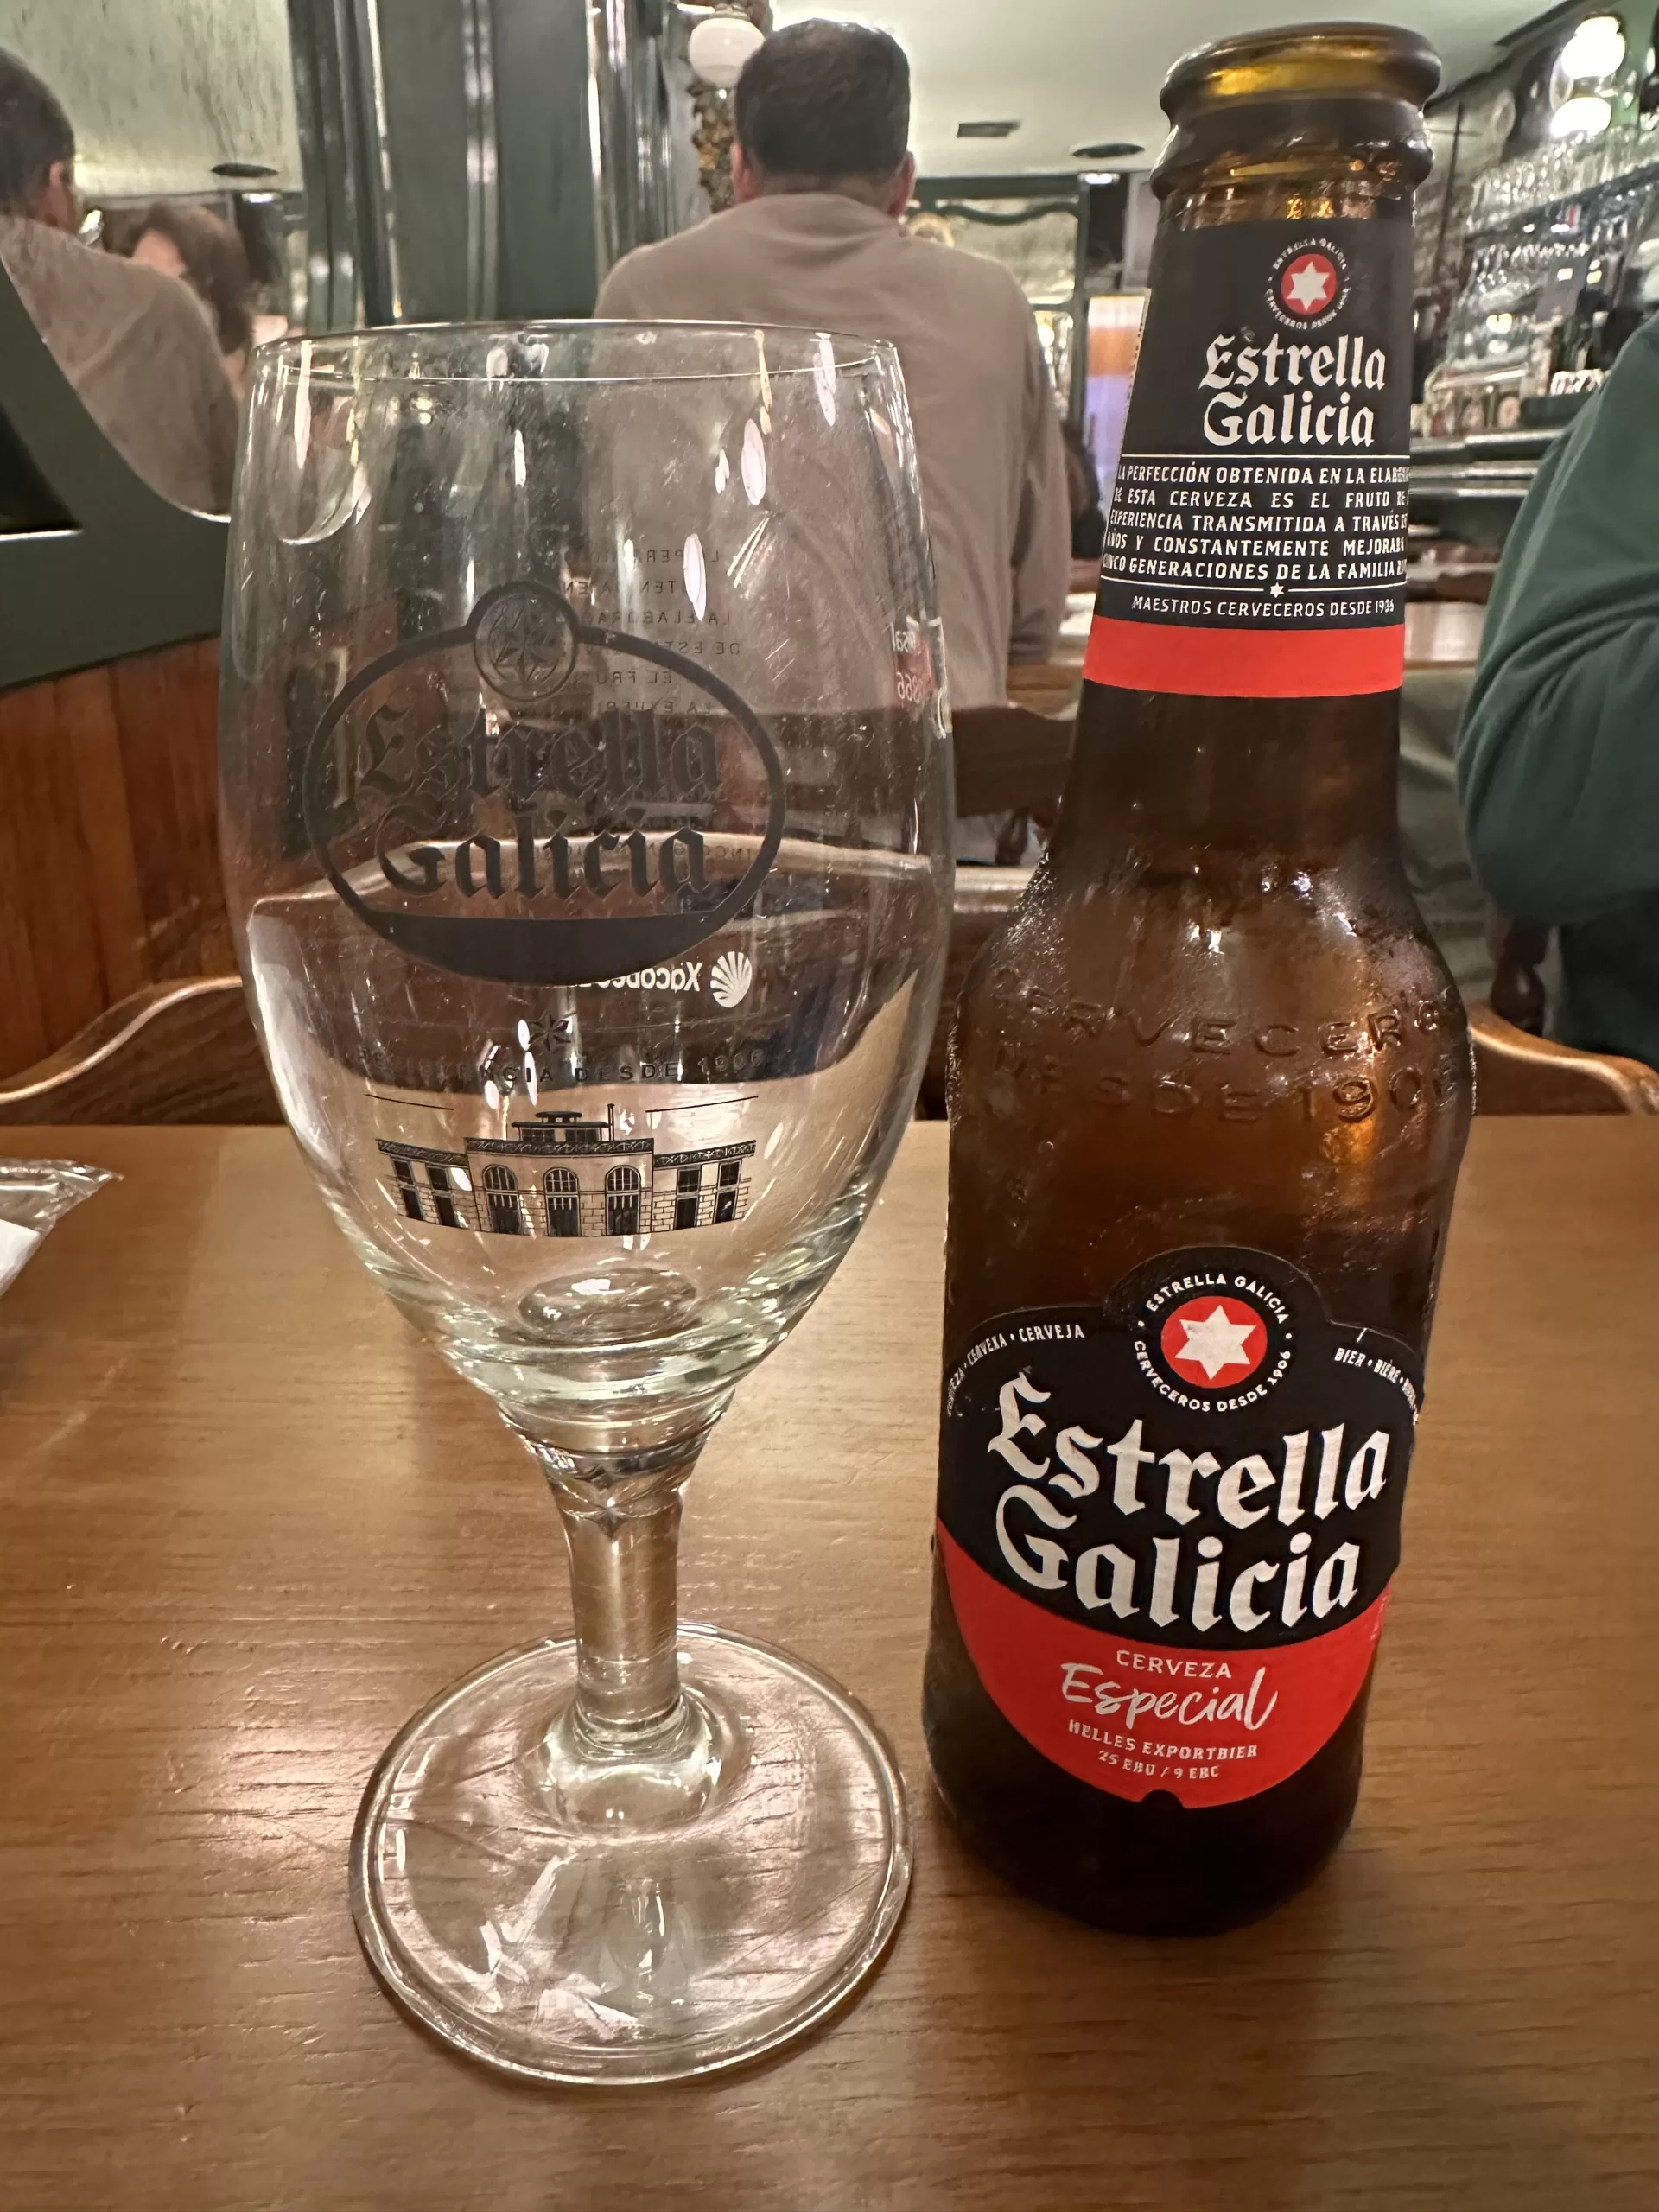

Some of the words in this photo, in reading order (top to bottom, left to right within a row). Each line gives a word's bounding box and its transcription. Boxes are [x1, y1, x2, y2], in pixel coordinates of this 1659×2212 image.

[1198, 332, 1386, 391] Estrella
[1203, 390, 1374, 447] Galicia
[1127, 461, 1210, 483] PERFECCIÓN
[1216, 467, 1313, 484] OBTENIDA
[1319, 467, 1340, 484] EN
[1345, 467, 1365, 484] LA
[1128, 488, 1156, 505] ESTA
[1170, 491, 1252, 509] CERVEZA
[1271, 493, 1293, 509] ES
[1310, 493, 1330, 509] EL
[1345, 490, 1389, 508] FRUTO
[1110, 508, 1183, 531] EXPERIENCIA
[1192, 515, 1326, 533] TRANSMITIDA
[1334, 516, 1345, 532] A
[1352, 510, 1399, 532] TRAVÉS
[1136, 535, 1144, 550] Y
[1154, 537, 1329, 556] CONSTANTEMENTE
[1128, 557, 1268, 581] GENERACIONES
[1277, 563, 1300, 581] DE
[1307, 562, 1331, 580] LA
[1338, 561, 1395, 580] FAMILIA
[1132, 594, 1211, 615] MAESTROS
[1217, 601, 1325, 618] CERVECEROS
[1330, 601, 1372, 616] DESDE
[358, 702, 721, 800] Estrella
[376, 801, 711, 899] Galicia
[1146, 1273, 1227, 1312] ESTRELLA
[1234, 1275, 1289, 1324] GALICIA
[1019, 1325, 1085, 1342] CERVEJA
[1334, 1348, 1366, 1367] BIER
[1134, 1340, 1211, 1412] CERVECEROS
[1217, 1384, 1268, 1412] DESDE
[1268, 1351, 1291, 1385] 1906
[988, 1372, 1389, 1529] Estrella
[995, 1484, 1360, 1632] Galicia
[1116, 1649, 1231, 1679] CERVEZA
[1060, 1662, 1278, 1731] Especial
[1068, 1719, 1135, 1751] HELLES
[1142, 1741, 1257, 1760] EXPORTBIER
[1098, 1750, 1117, 1765] 25
[1122, 1759, 1154, 1776] EBU
[1173, 1768, 1183, 1778] 9
[1188, 1765, 1219, 1779] EBC
